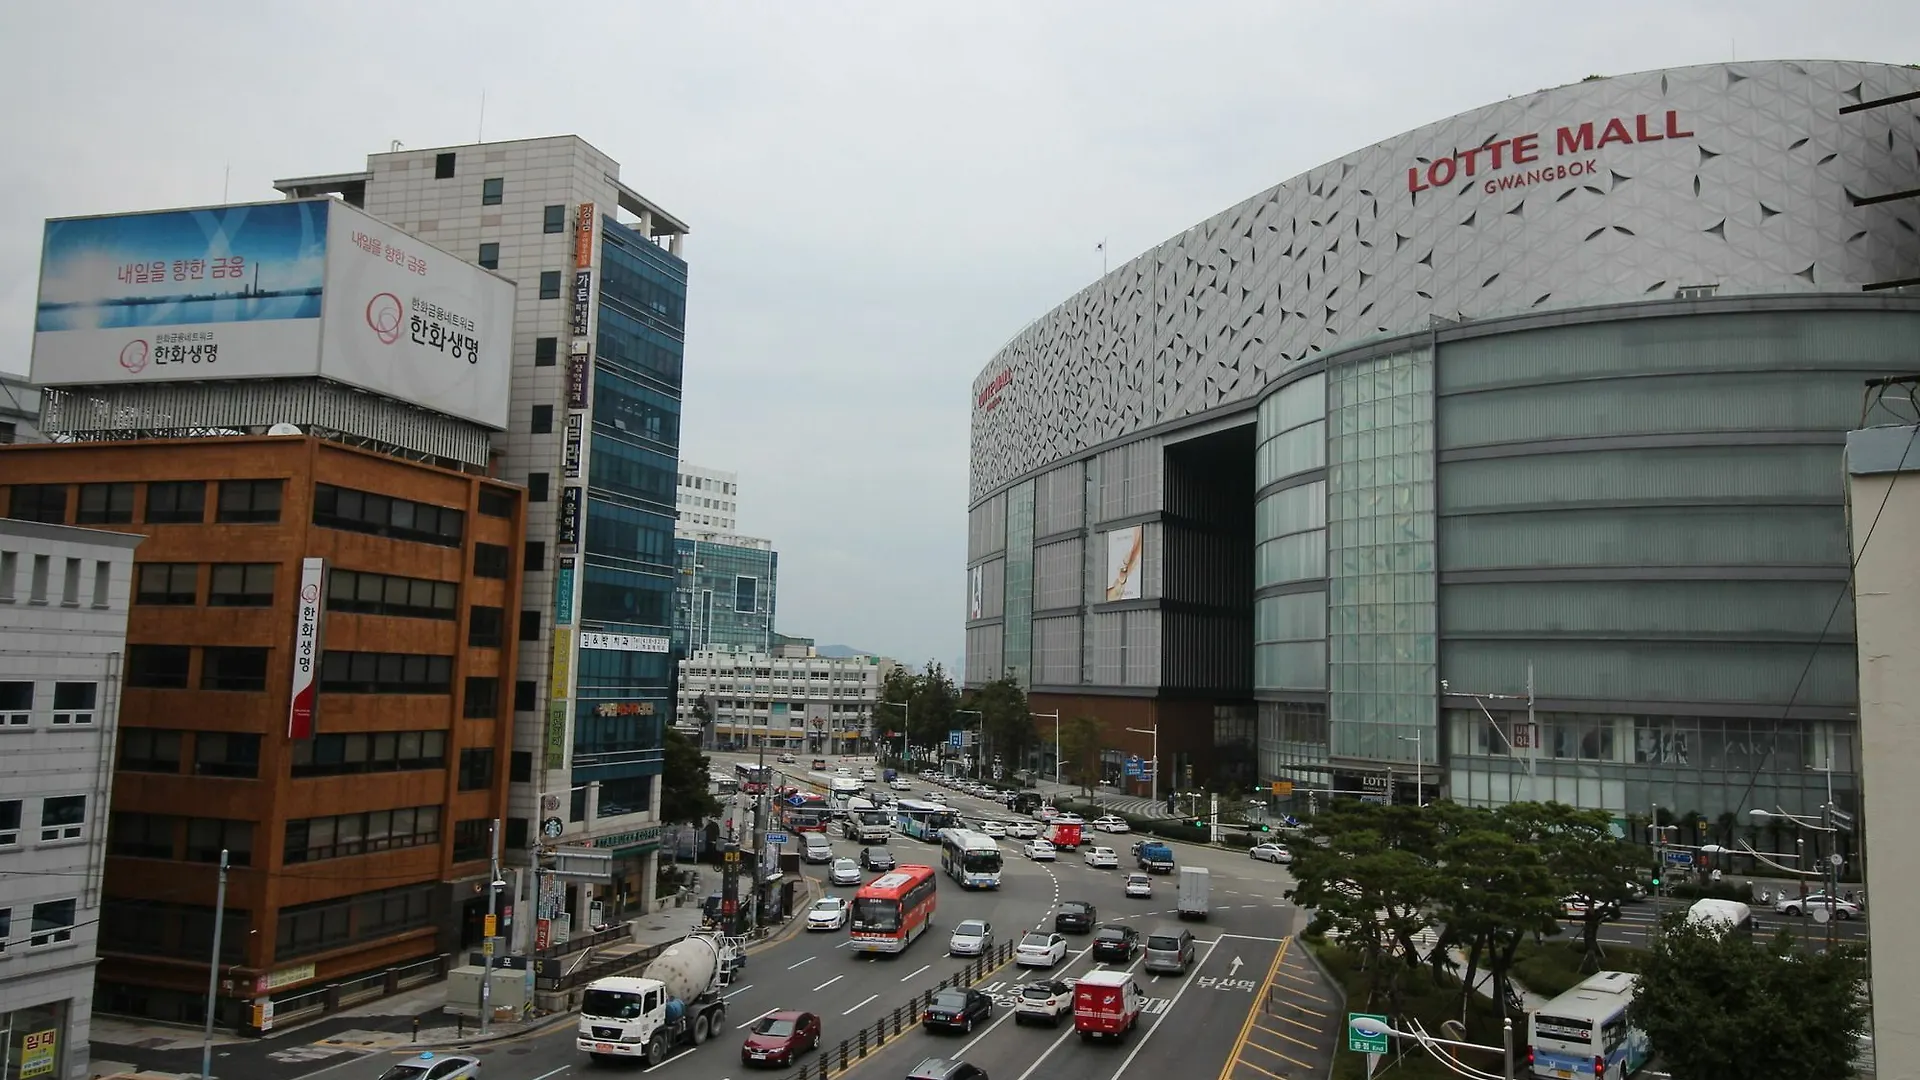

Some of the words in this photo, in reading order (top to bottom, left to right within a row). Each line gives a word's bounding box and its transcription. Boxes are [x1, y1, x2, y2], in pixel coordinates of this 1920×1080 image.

[1408, 133, 1539, 193] LOTTE
[1556, 110, 1694, 155] MALL
[1484, 159, 1597, 194] GWANGBOK
[117, 260, 166, 285] 내일을
[173, 259, 206, 282] 향한
[211, 256, 245, 280] 금융
[352, 230, 382, 257] 내일을
[385, 244, 405, 266] 향한
[407, 254, 428, 277] 금융
[411, 297, 475, 332] 한화금융네트워크
[154, 343, 218, 365] 한화생명
[156, 331, 214, 343] 한화금융네트워크
[410, 315, 479, 365] 한화생명
[299, 606, 315, 673] 한화생명
[1197, 976, 1256, 992] 부산역
[27, 1031, 55, 1049] 임대
